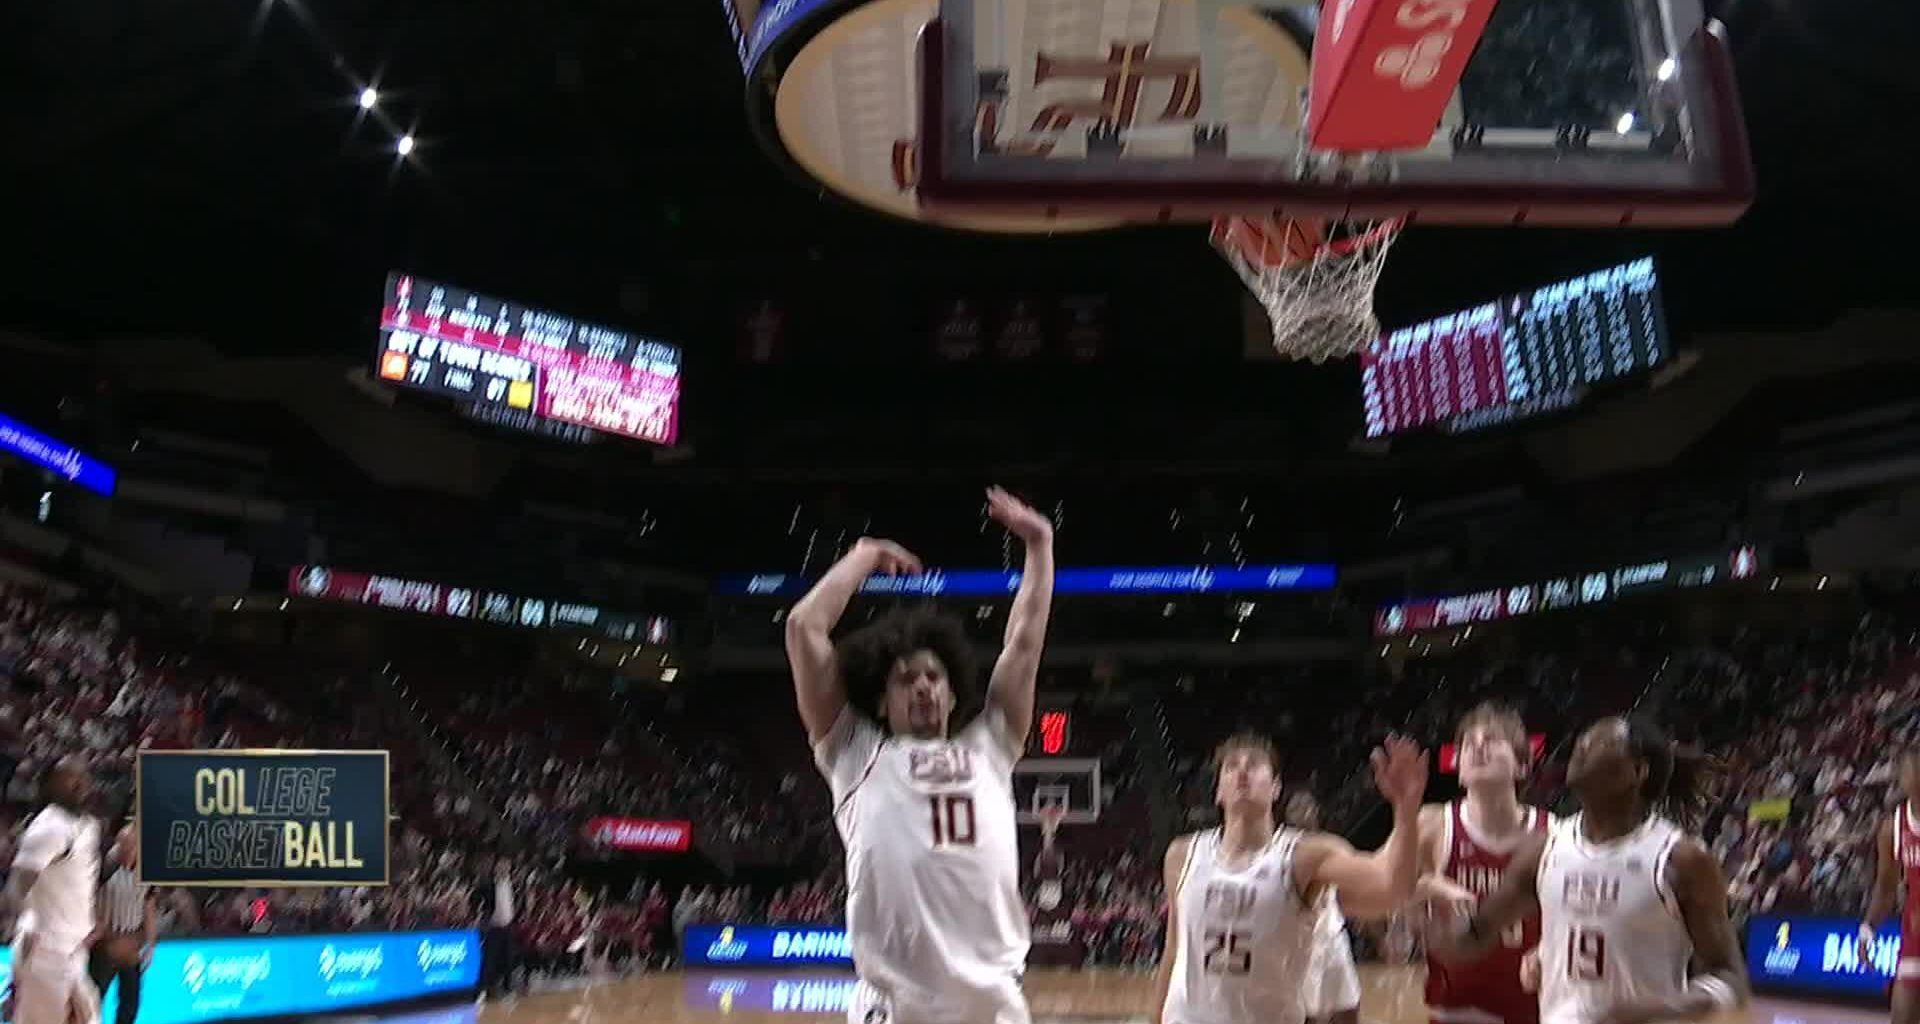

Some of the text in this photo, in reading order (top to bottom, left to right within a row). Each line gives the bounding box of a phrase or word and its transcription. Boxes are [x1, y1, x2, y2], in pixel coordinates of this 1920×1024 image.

[929, 793, 977, 847] 10
[1203, 928, 1253, 977] 25
[1567, 924, 1606, 981] 19
